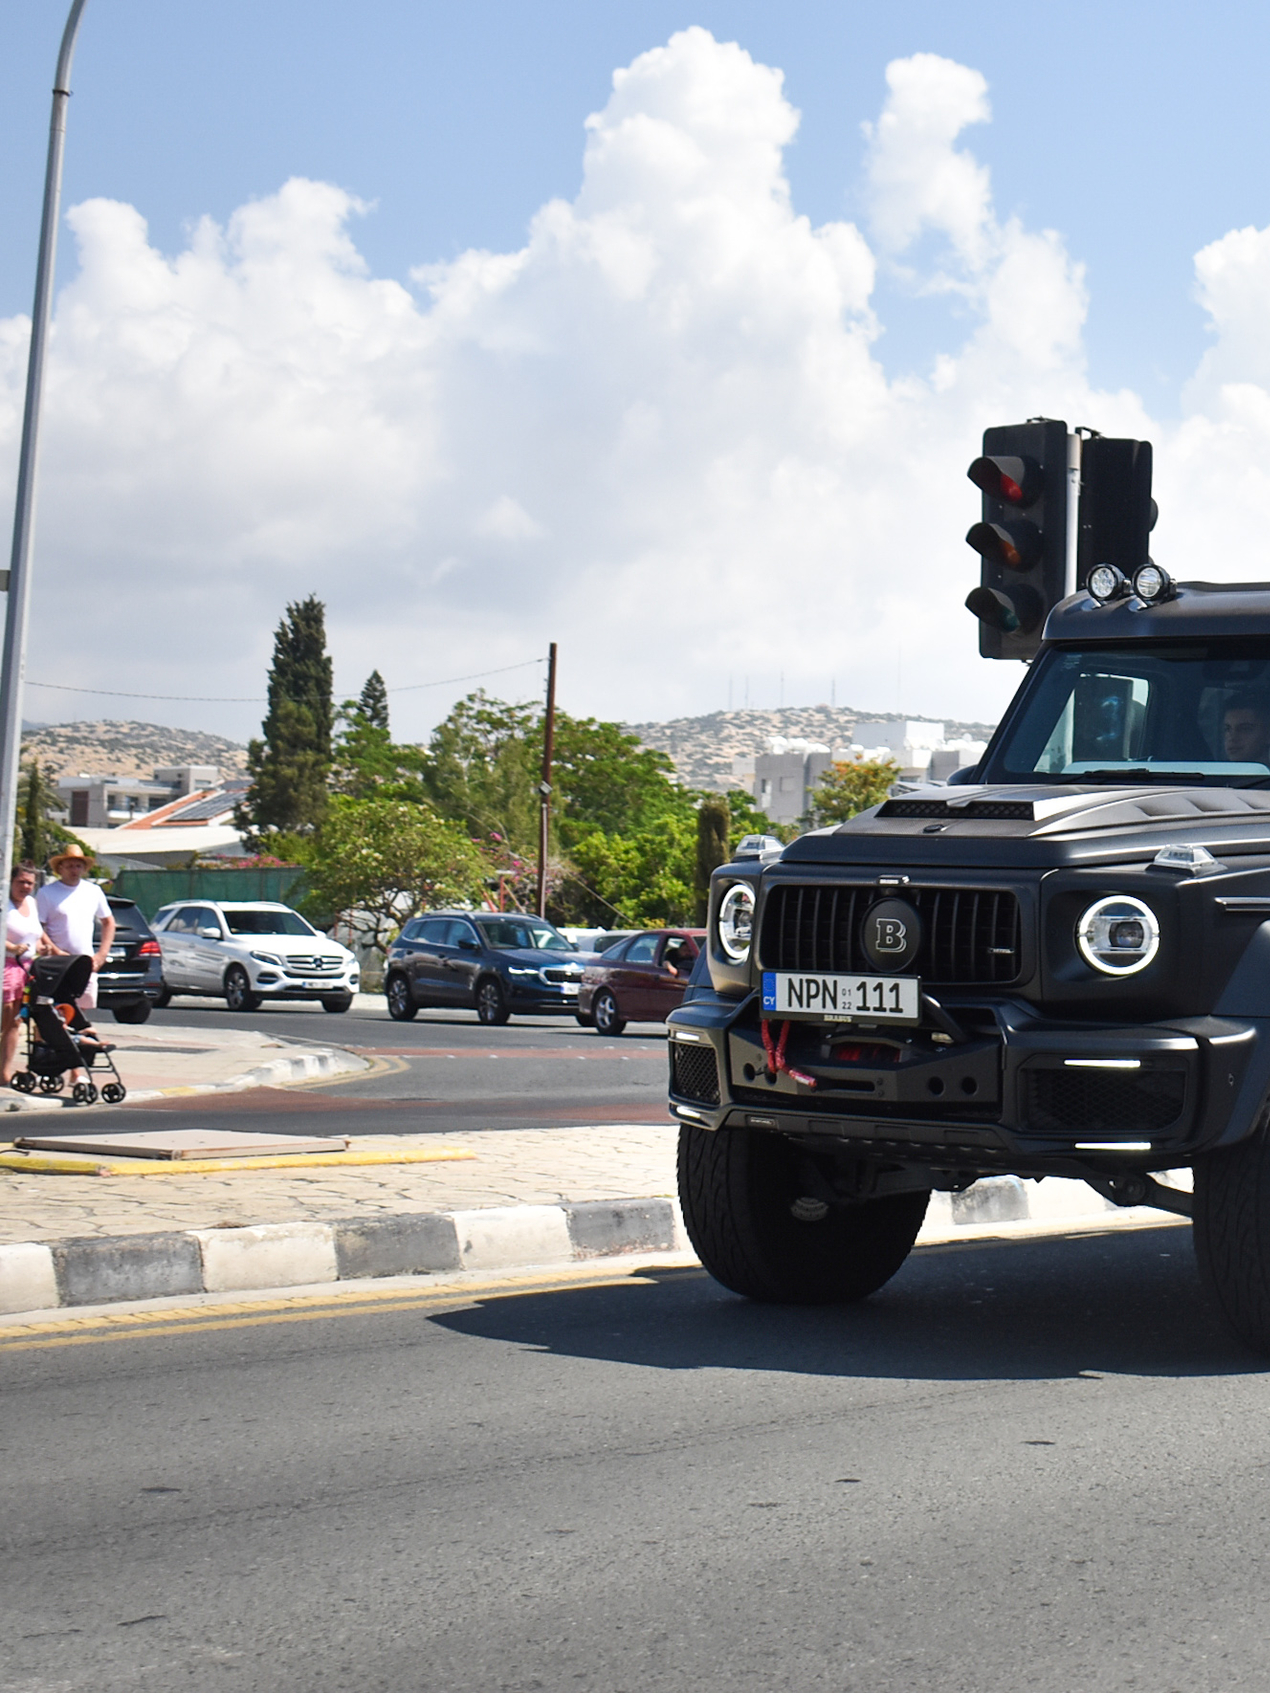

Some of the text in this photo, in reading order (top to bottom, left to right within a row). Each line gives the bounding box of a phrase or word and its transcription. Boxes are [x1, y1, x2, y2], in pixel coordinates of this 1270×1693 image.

[876, 918, 907, 953] B
[763, 996, 776, 1005] CY
[787, 977, 904, 1013] NPN 111
